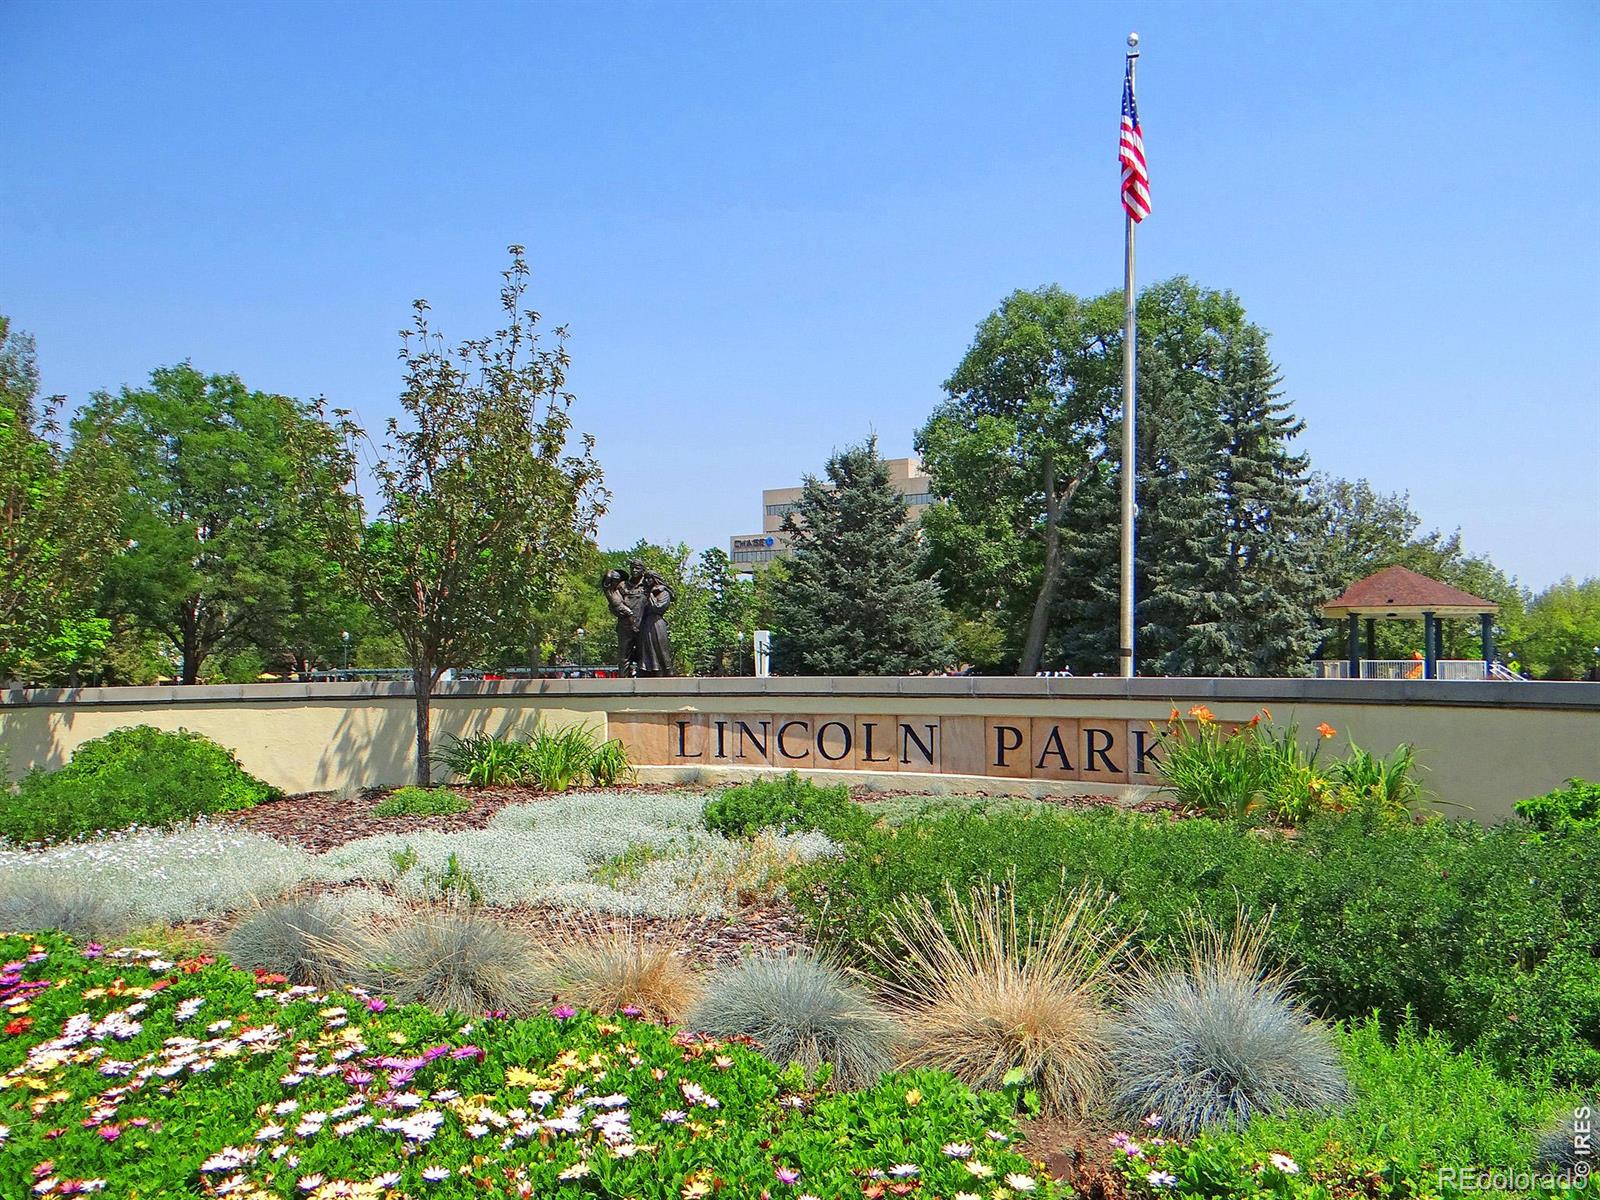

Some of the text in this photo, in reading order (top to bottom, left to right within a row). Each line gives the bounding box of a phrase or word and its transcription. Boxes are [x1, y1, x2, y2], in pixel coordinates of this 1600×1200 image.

[734, 538, 765, 548] CHASE
[675, 720, 1171, 776] LINCOLN PARK
